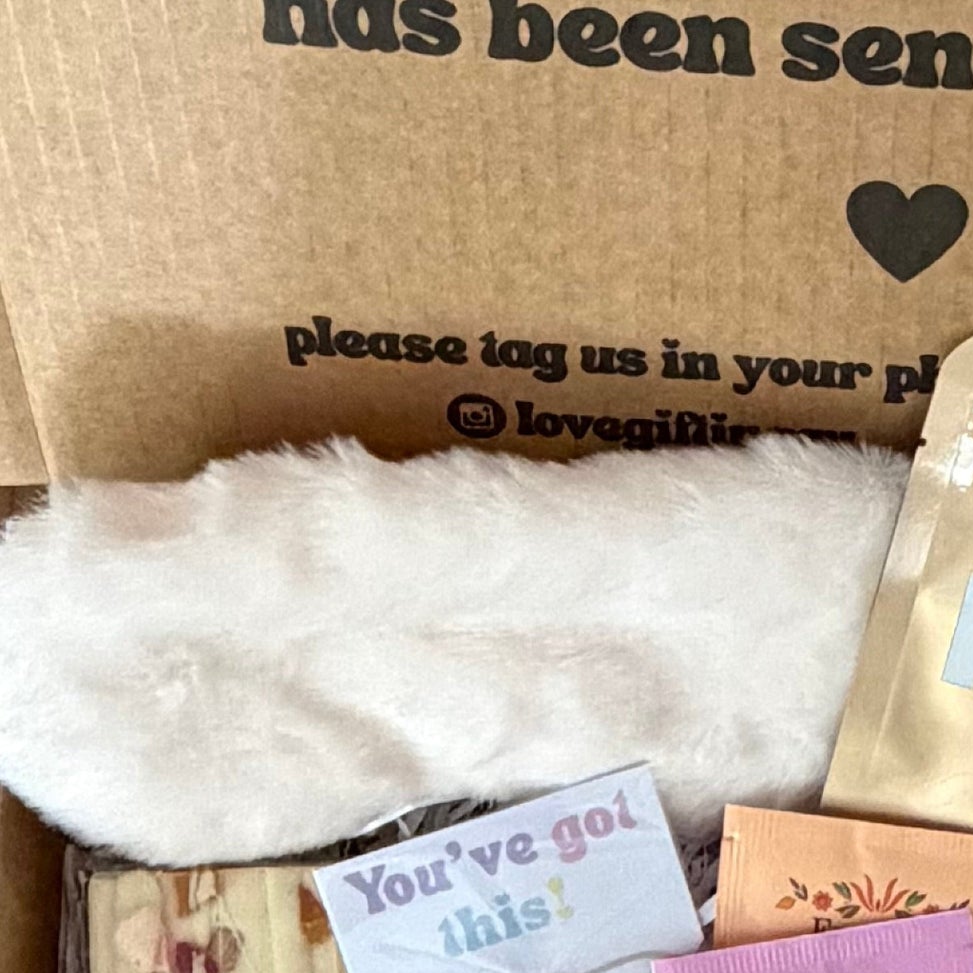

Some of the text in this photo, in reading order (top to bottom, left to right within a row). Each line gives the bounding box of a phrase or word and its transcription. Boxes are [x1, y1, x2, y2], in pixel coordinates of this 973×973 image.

[488, 0, 755, 76] been
[284, 315, 467, 365] please
[480, 331, 566, 382] tag
[580, 344, 647, 377] us
[661, 339, 720, 381] in
[733, 353, 872, 394] your
[551, 789, 637, 863] got
[438, 876, 574, 956] this!
